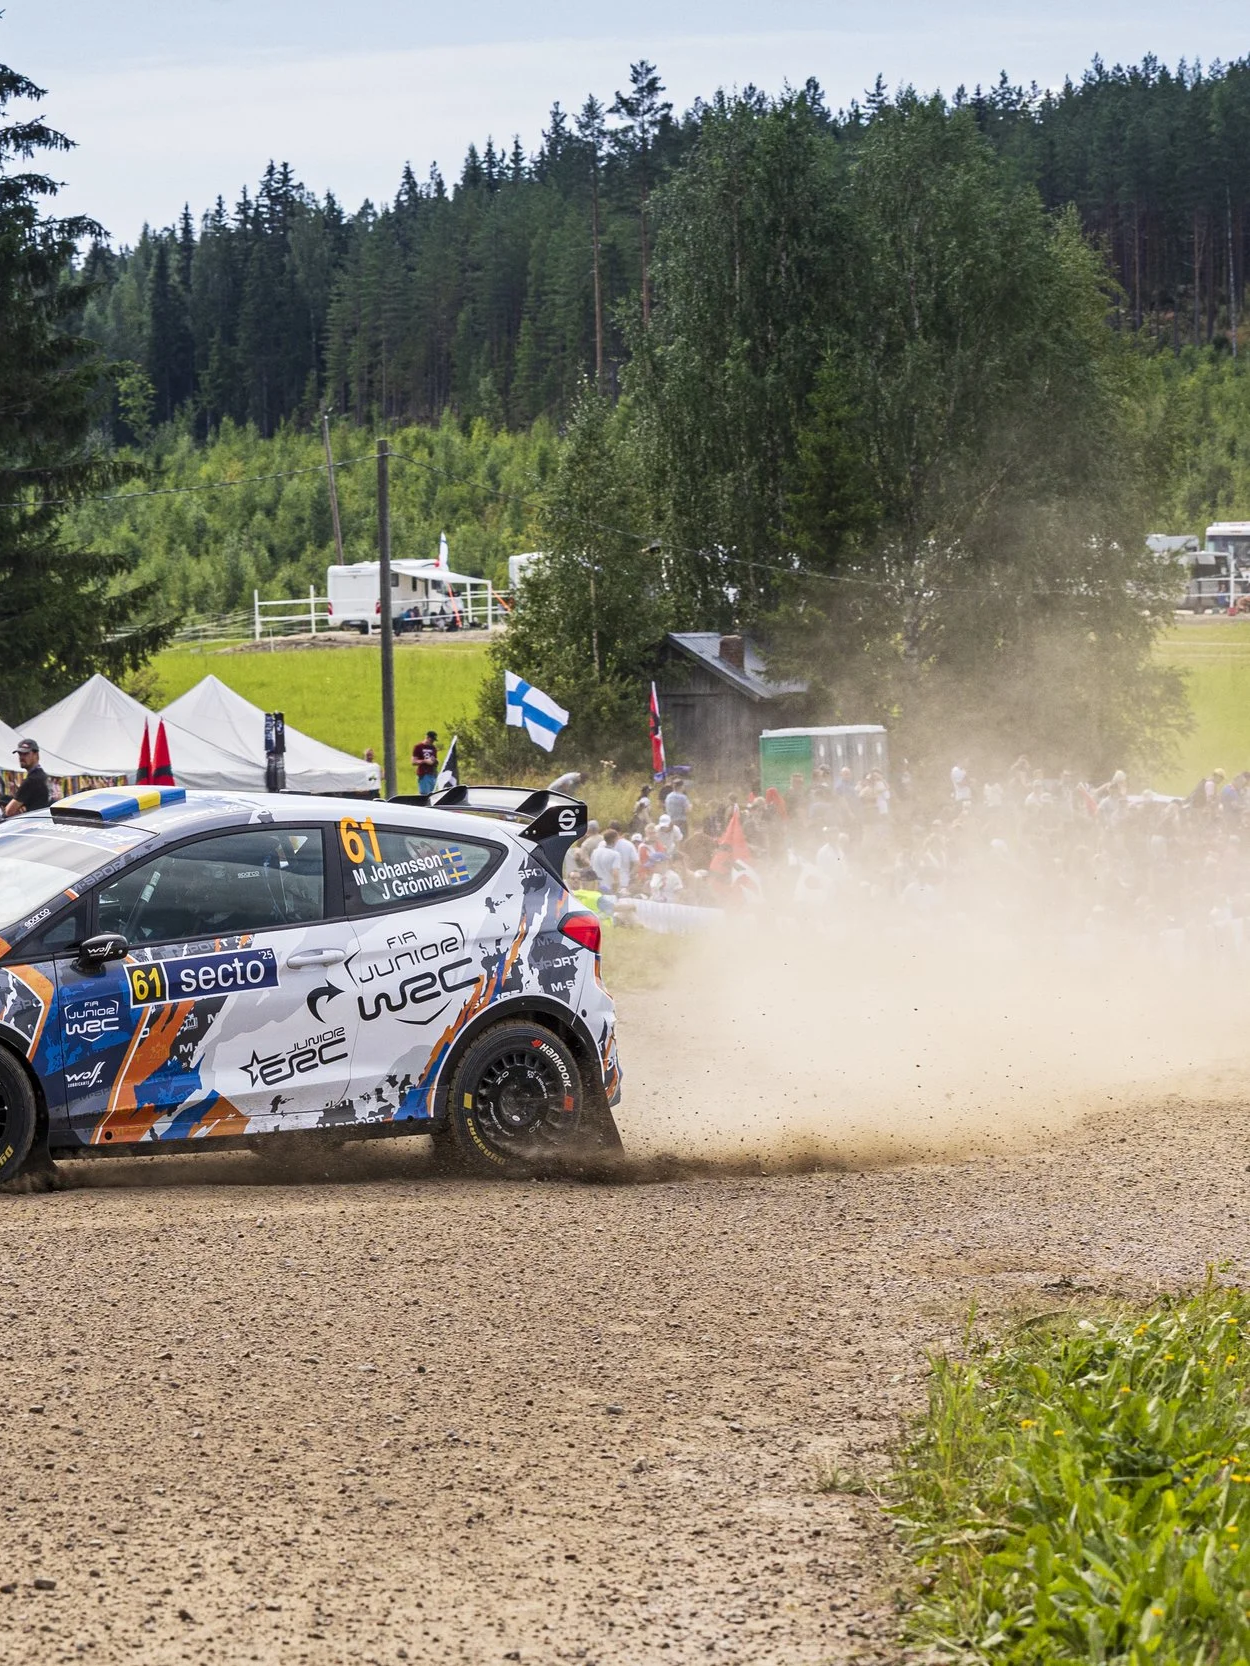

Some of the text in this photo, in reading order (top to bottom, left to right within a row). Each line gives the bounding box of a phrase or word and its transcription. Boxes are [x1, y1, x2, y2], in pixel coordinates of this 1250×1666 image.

[340, 816, 382, 864] 61
[352, 854, 443, 886] M Johansson
[382, 869, 450, 900] J Grönvall
[24, 908, 51, 929] sparco
[87, 941, 114, 956] wolf
[387, 931, 417, 949] FIA
[359, 936, 459, 983] JUNIOR
[132, 956, 265, 1000] 61 secto
[358, 957, 481, 1021] WRC
[66, 1018, 119, 1035] WRC
[68, 1006, 116, 1019] JUNIOR
[288, 1027, 345, 1054] JUNIOR
[65, 1061, 105, 1087] wolf
[259, 1037, 348, 1086] ERC
